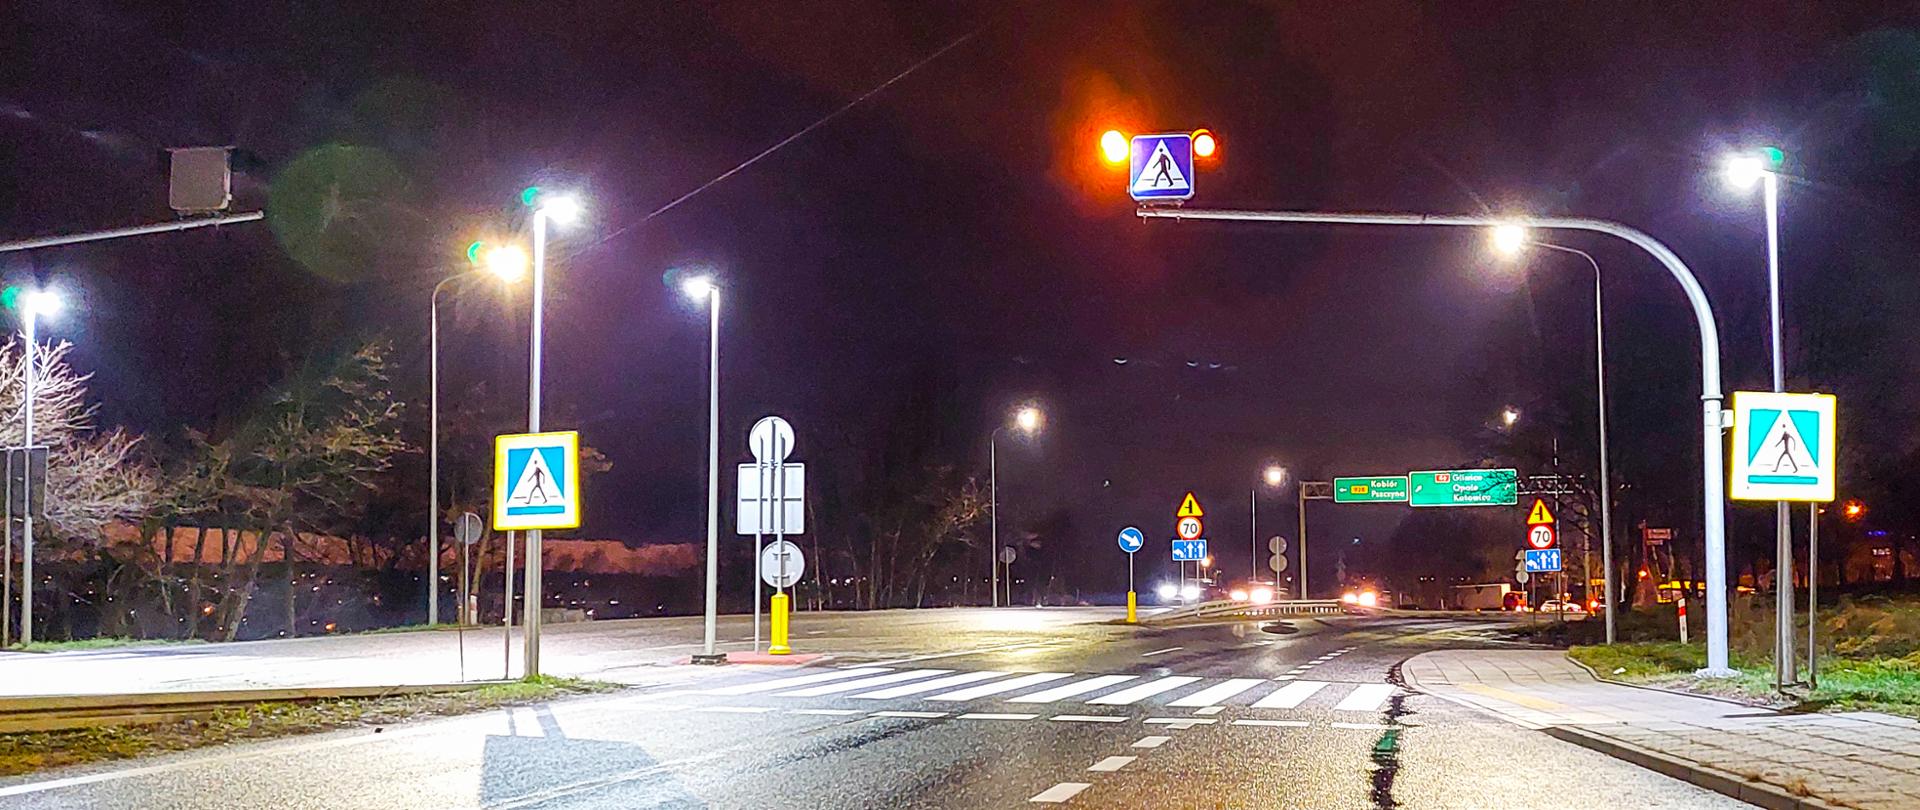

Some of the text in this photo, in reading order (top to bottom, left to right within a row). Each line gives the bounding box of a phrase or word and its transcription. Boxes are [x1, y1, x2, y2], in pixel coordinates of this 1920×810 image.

[1370, 480, 1398, 488] Kobiór
[1452, 484, 1479, 492] Opole
[1371, 490, 1405, 499] Pszczyna
[1453, 494, 1491, 502] Katowice
[1183, 523, 1198, 534] 70
[1535, 530, 1550, 543] 70
